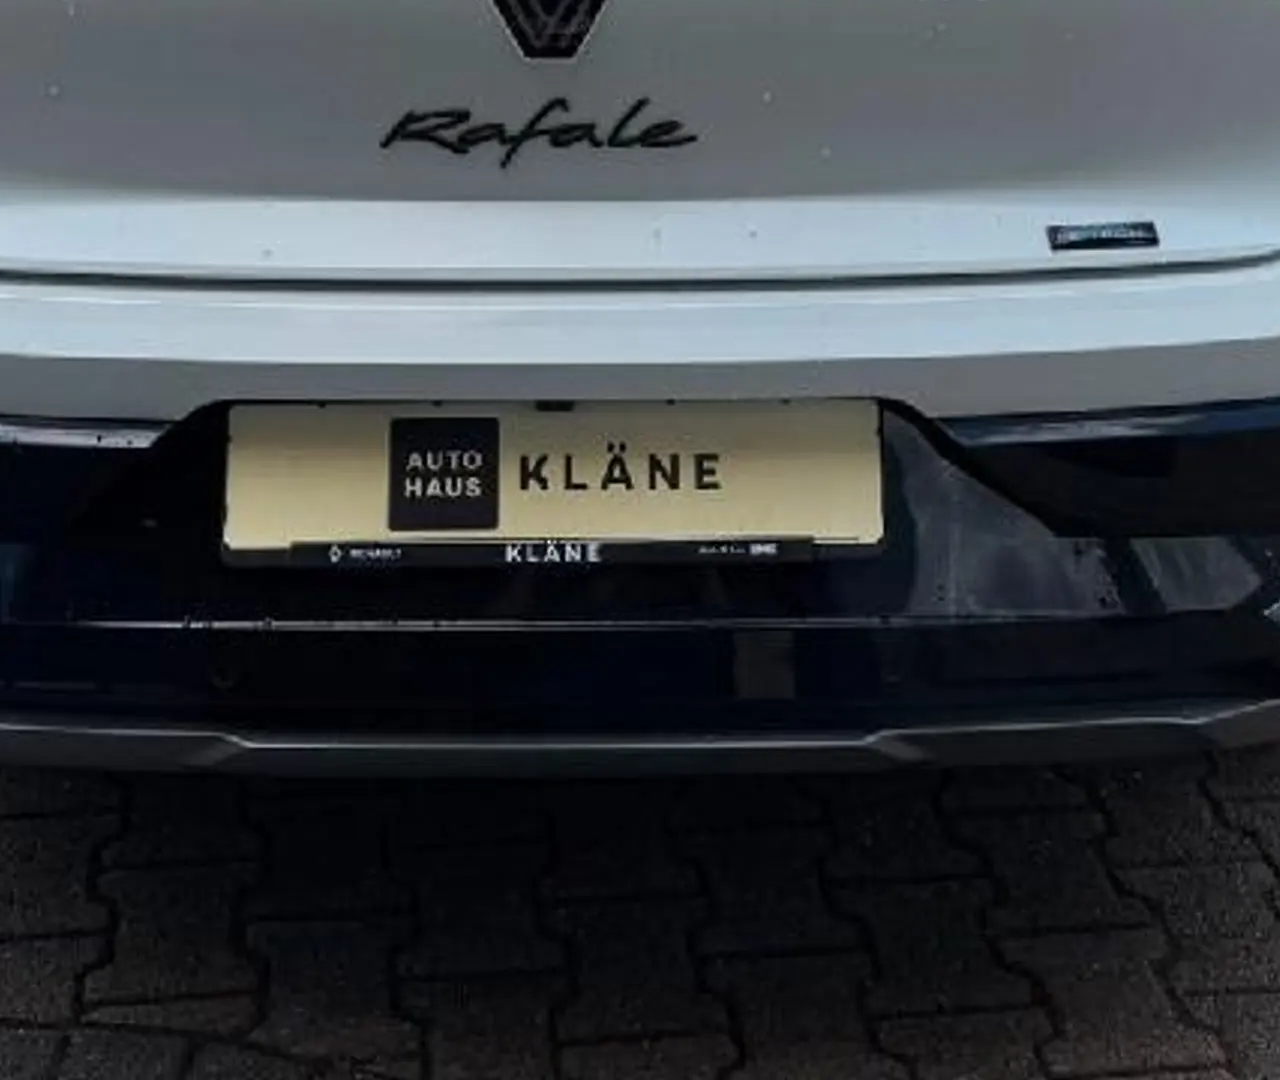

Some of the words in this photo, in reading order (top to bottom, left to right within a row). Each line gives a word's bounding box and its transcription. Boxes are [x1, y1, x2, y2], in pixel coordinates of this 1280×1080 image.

[379, 97, 699, 169] Rafale
[405, 449, 483, 470] AUTO
[519, 441, 722, 491] KLÄNE
[404, 475, 483, 498] HAUS
[504, 539, 603, 563] KLÄNE
